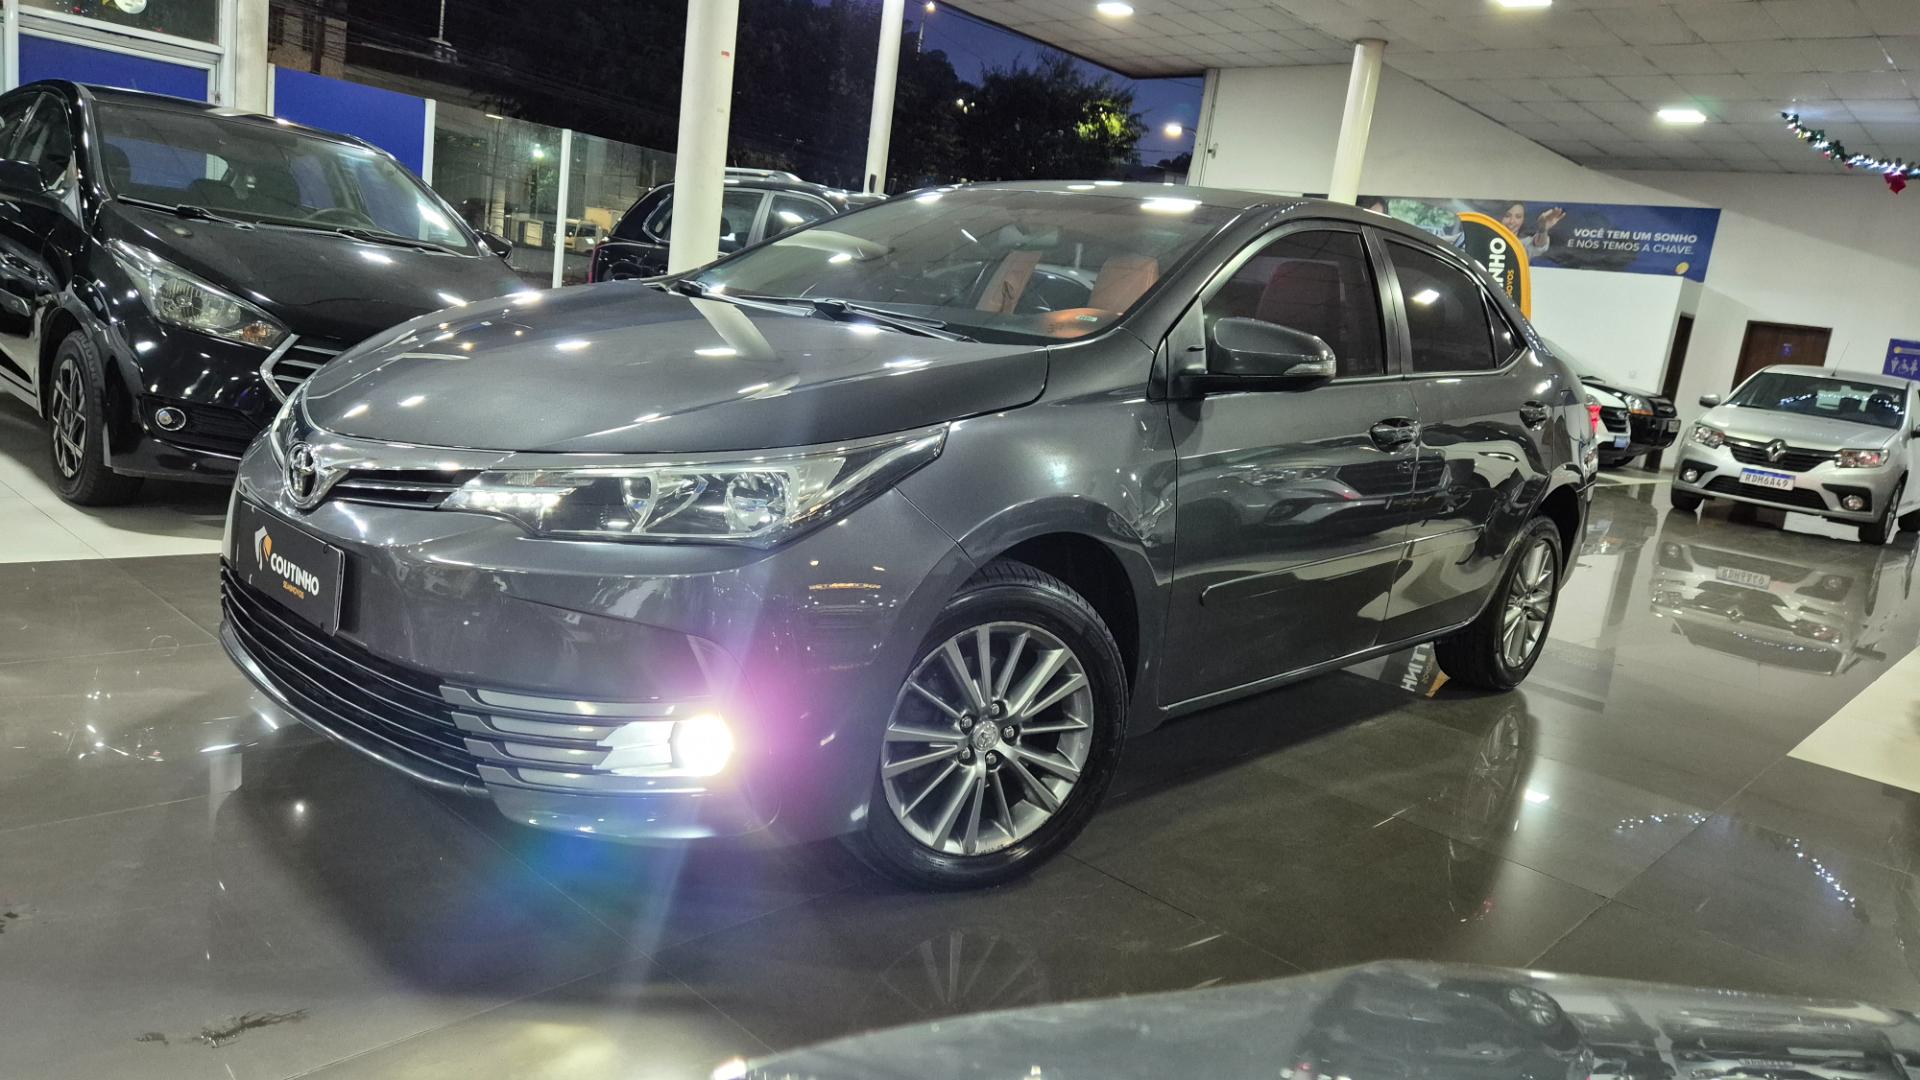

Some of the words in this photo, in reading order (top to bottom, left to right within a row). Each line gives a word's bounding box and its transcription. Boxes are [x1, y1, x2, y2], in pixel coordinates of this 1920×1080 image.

[1567, 239, 1574, 248] E
[1576, 238, 1599, 249] NÓS
[1602, 240, 1640, 252] TEMOS
[1641, 243, 1650, 252] A
[1653, 243, 1694, 255] CHAVE.
[1574, 228, 1604, 238] VOCÊ
[1607, 230, 1630, 240] TEM
[1632, 232, 1651, 241] UM
[1653, 233, 1698, 244] SONHO
[1488, 237, 1507, 288] NHO
[270, 552, 320, 597] COUTINHO
